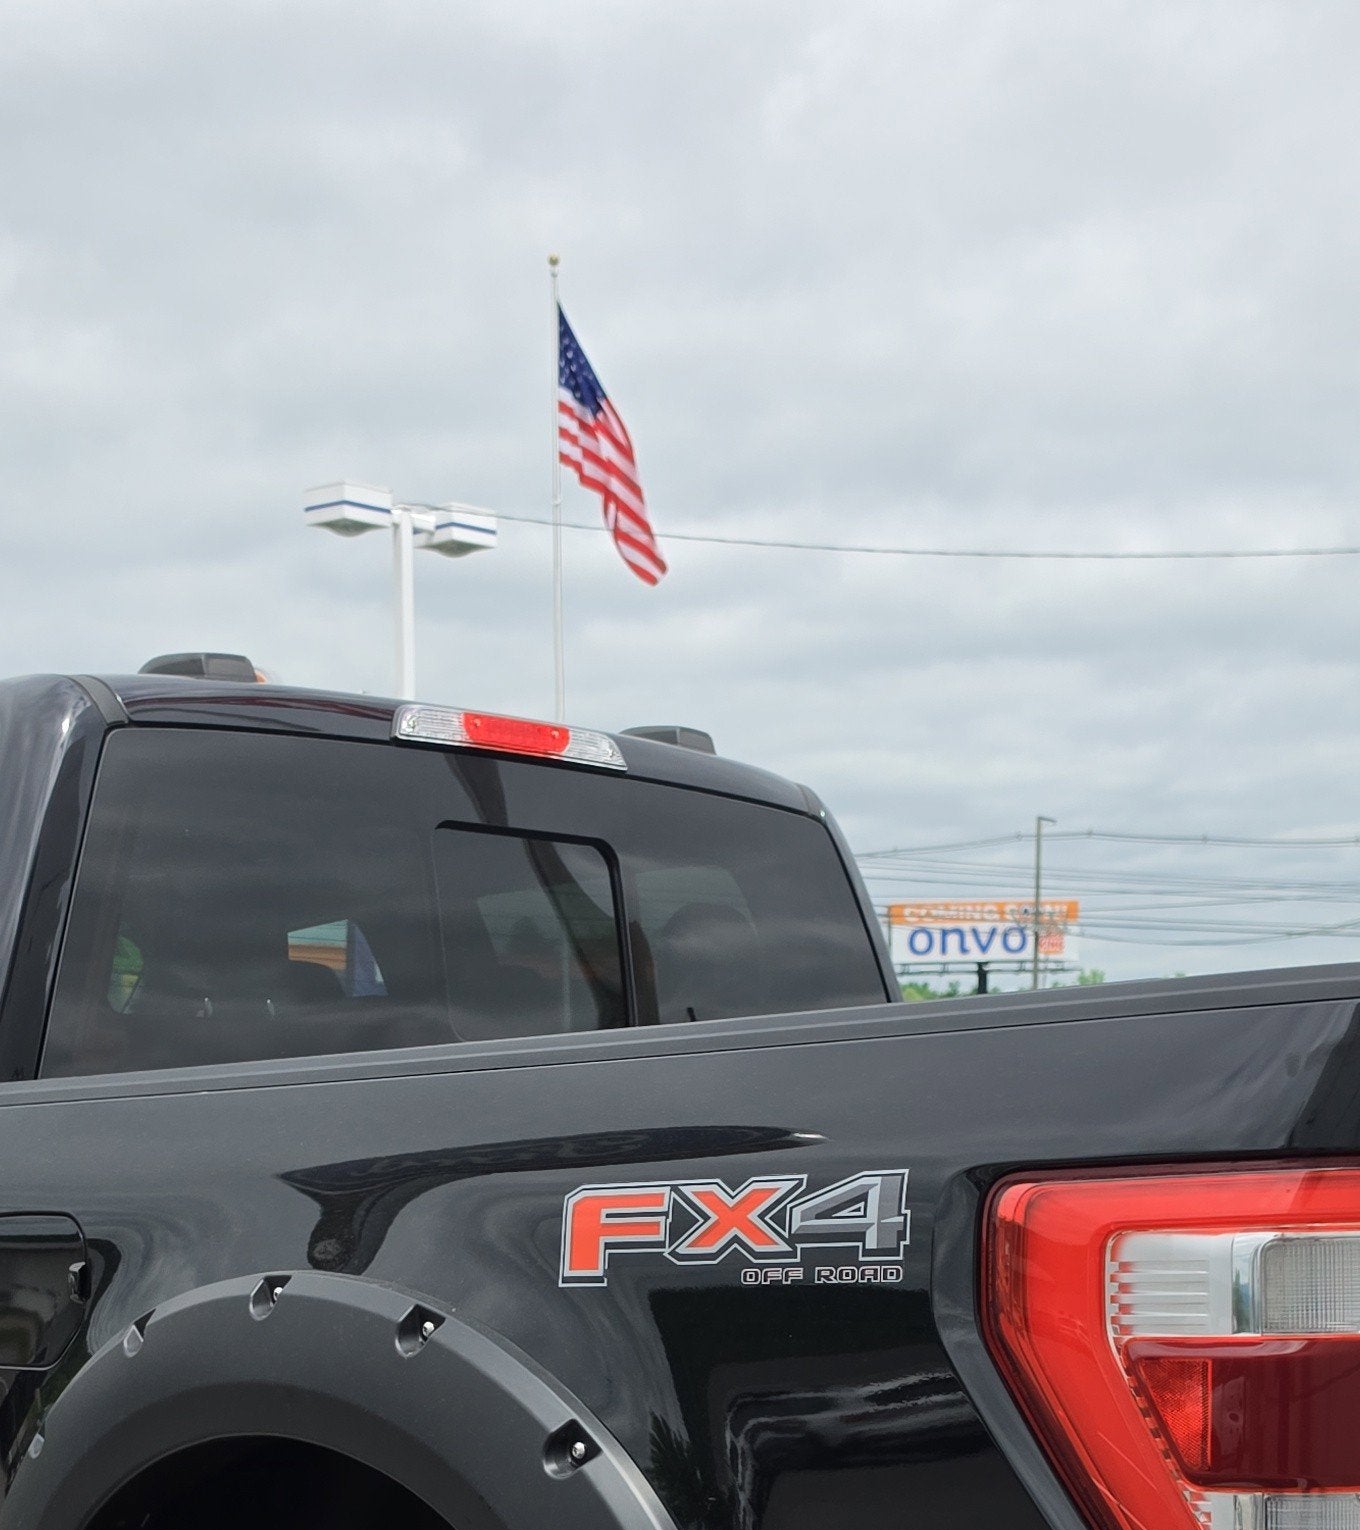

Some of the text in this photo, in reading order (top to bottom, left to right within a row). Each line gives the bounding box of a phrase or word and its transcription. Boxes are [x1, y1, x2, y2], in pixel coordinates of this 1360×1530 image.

[908, 926, 1028, 956] onvo
[558, 1168, 911, 1288] FX4
[740, 1265, 904, 1285] OFF ROAD
